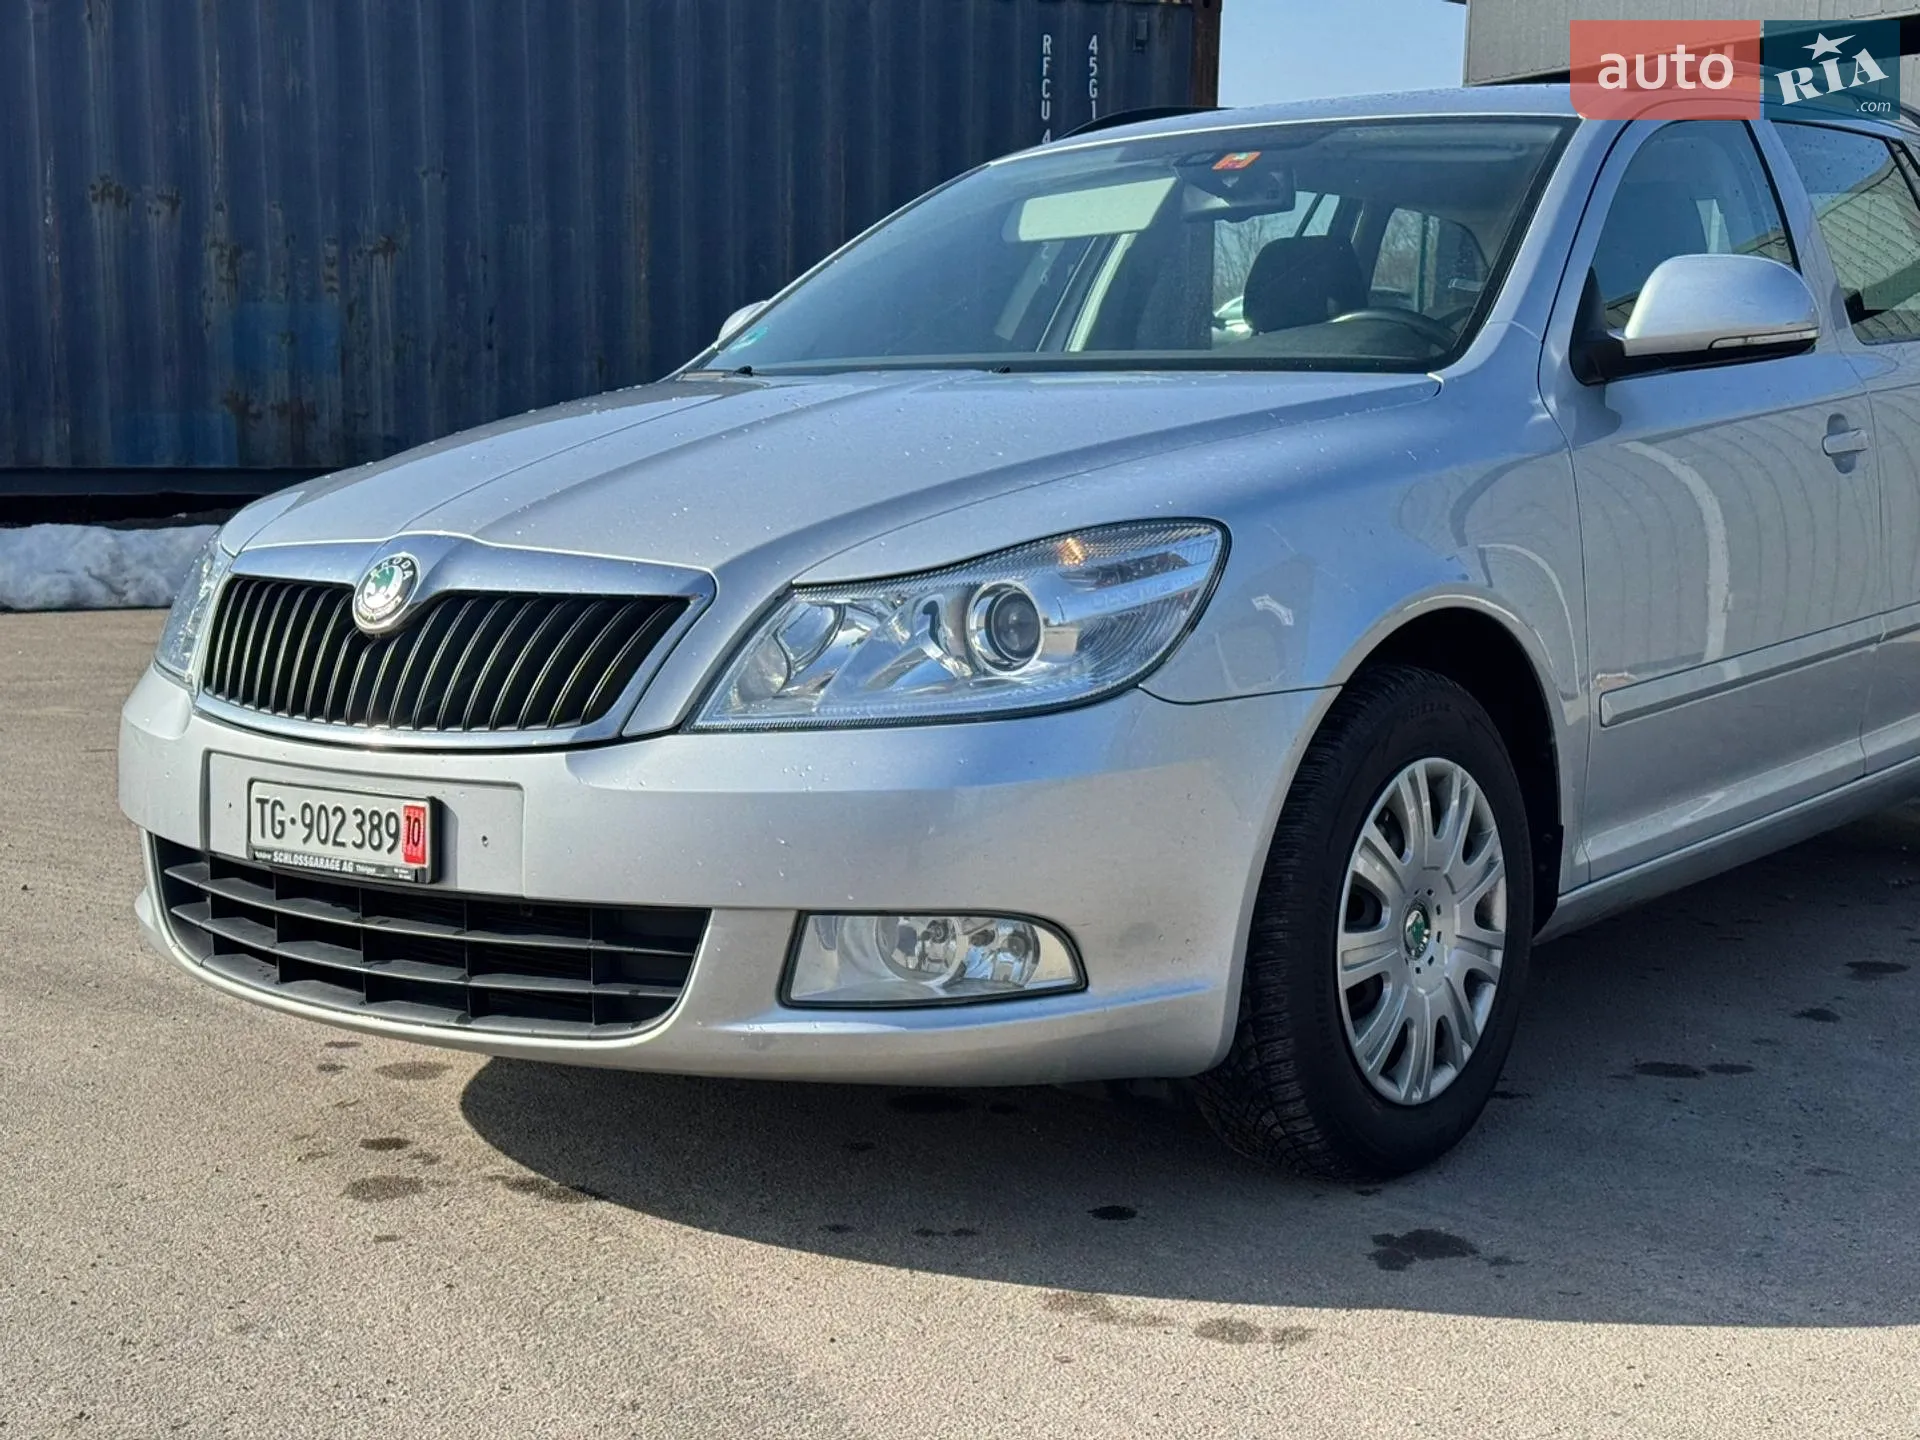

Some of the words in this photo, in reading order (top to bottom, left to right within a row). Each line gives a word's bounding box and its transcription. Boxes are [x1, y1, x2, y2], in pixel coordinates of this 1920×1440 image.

[1041, 33, 1052, 121] RFCU
[1088, 34, 1099, 121] 45G1
[273, 850, 341, 871] SCHLOSSGARAGE
[405, 815, 421, 847] 10
